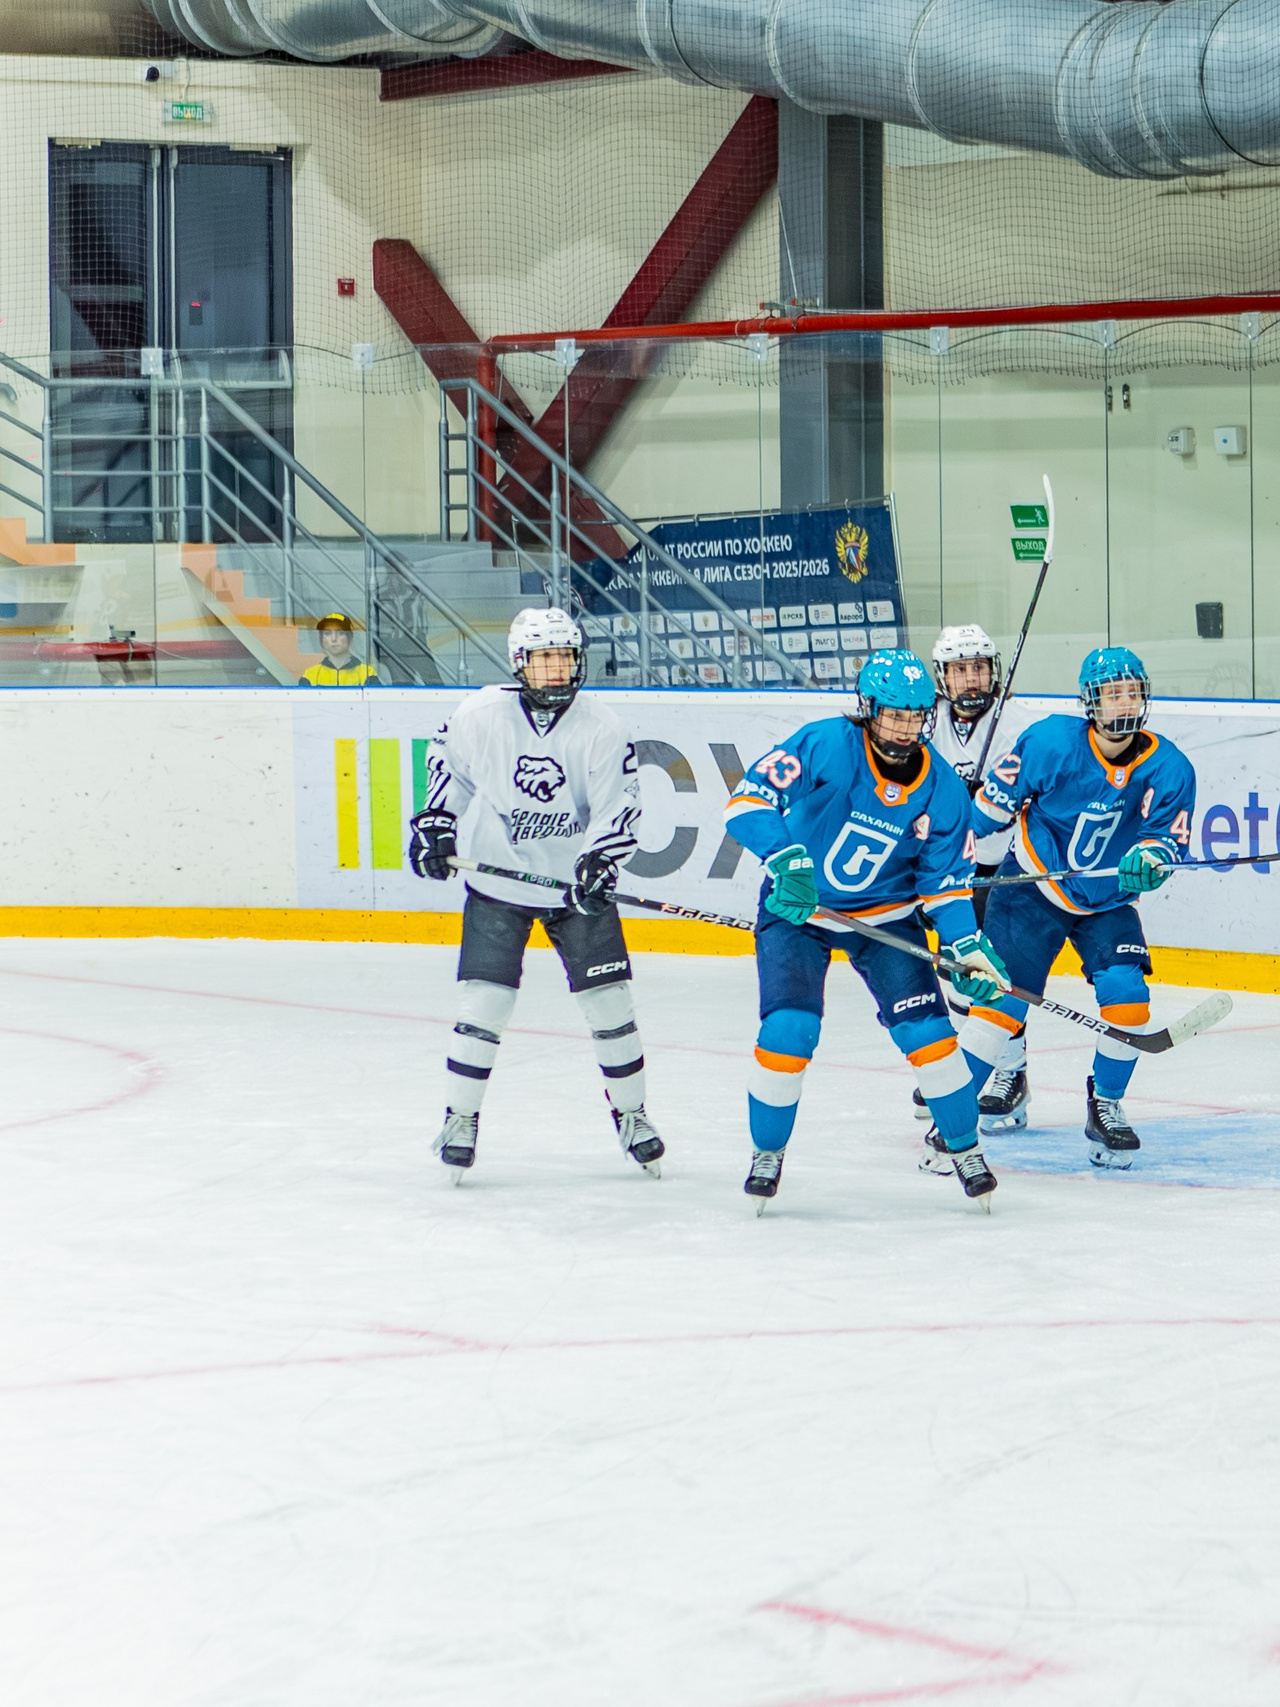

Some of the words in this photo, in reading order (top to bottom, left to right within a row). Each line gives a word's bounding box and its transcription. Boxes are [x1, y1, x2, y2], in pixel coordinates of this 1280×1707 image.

[172, 106, 203, 119] ВЫХОД
[677, 540, 723, 560] РОССИИ
[724, 538, 742, 556] ПО
[744, 534, 793, 554] ХОККЕЮ
[1015, 541, 1045, 552] ВЫХОД
[703, 565, 732, 583] ЛИГА
[772, 559, 830, 579] 2025/2026
[850, 811, 904, 836] САХАЛИН
[586, 961, 628, 977] CCM
[893, 992, 937, 1014] CCM
[1040, 998, 1111, 1035] BAUER
